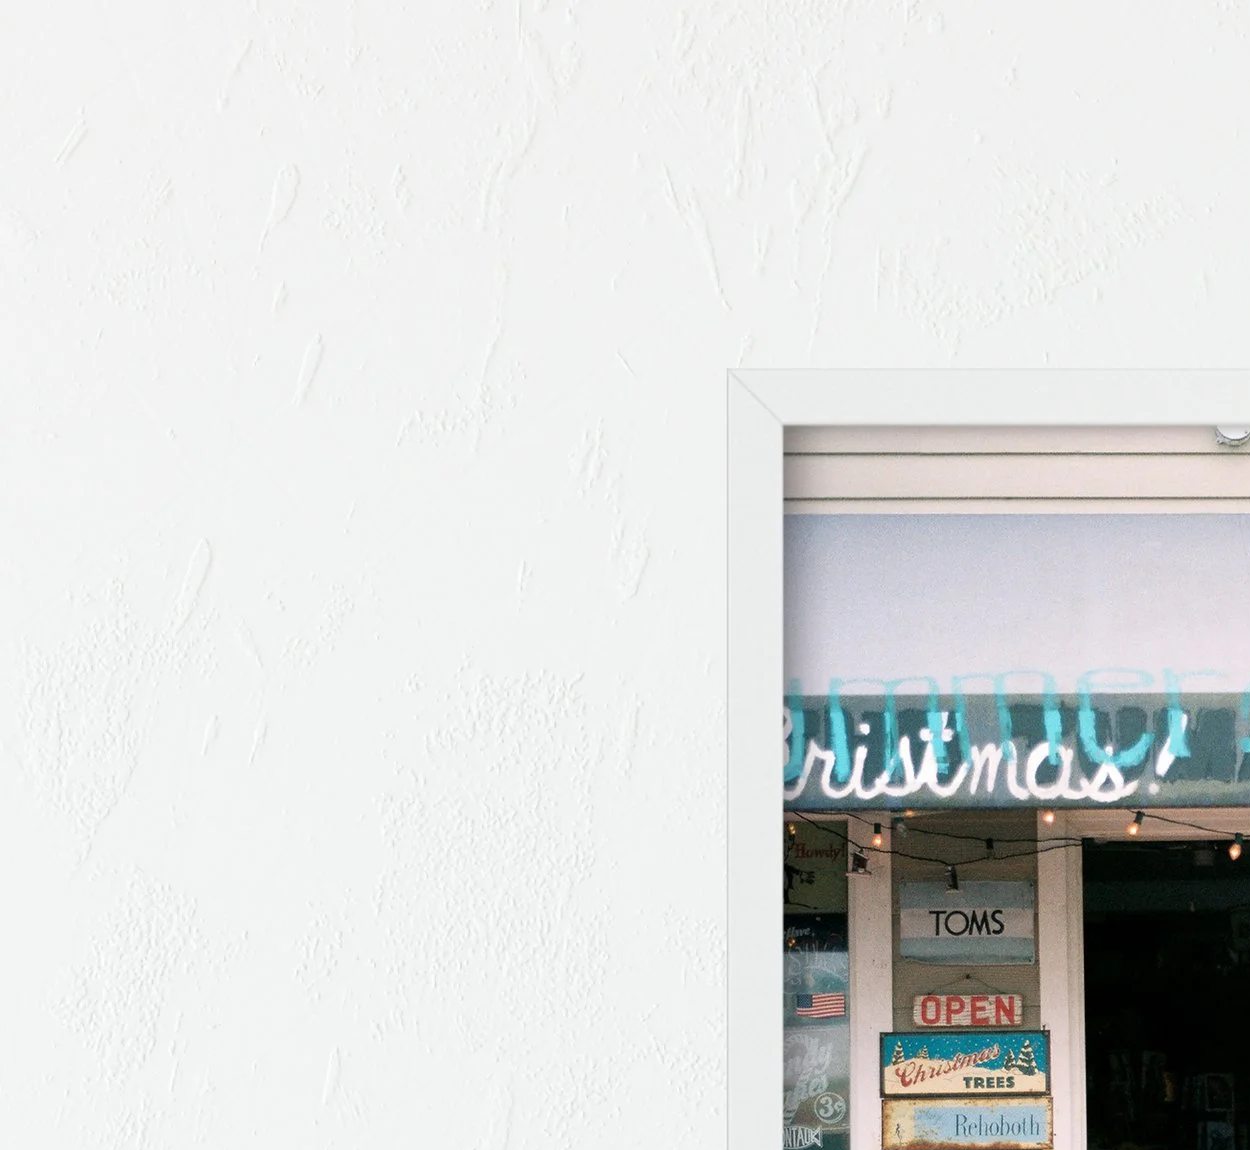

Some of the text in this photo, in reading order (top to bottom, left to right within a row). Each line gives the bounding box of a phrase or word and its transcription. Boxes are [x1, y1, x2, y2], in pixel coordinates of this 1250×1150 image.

[929, 909, 1005, 937] TOMS
[920, 995, 1016, 1025] OPEN
[895, 1042, 1001, 1088] Christmas
[963, 1076, 1015, 1089] TREES
[954, 1112, 1041, 1137] Rehoboth
